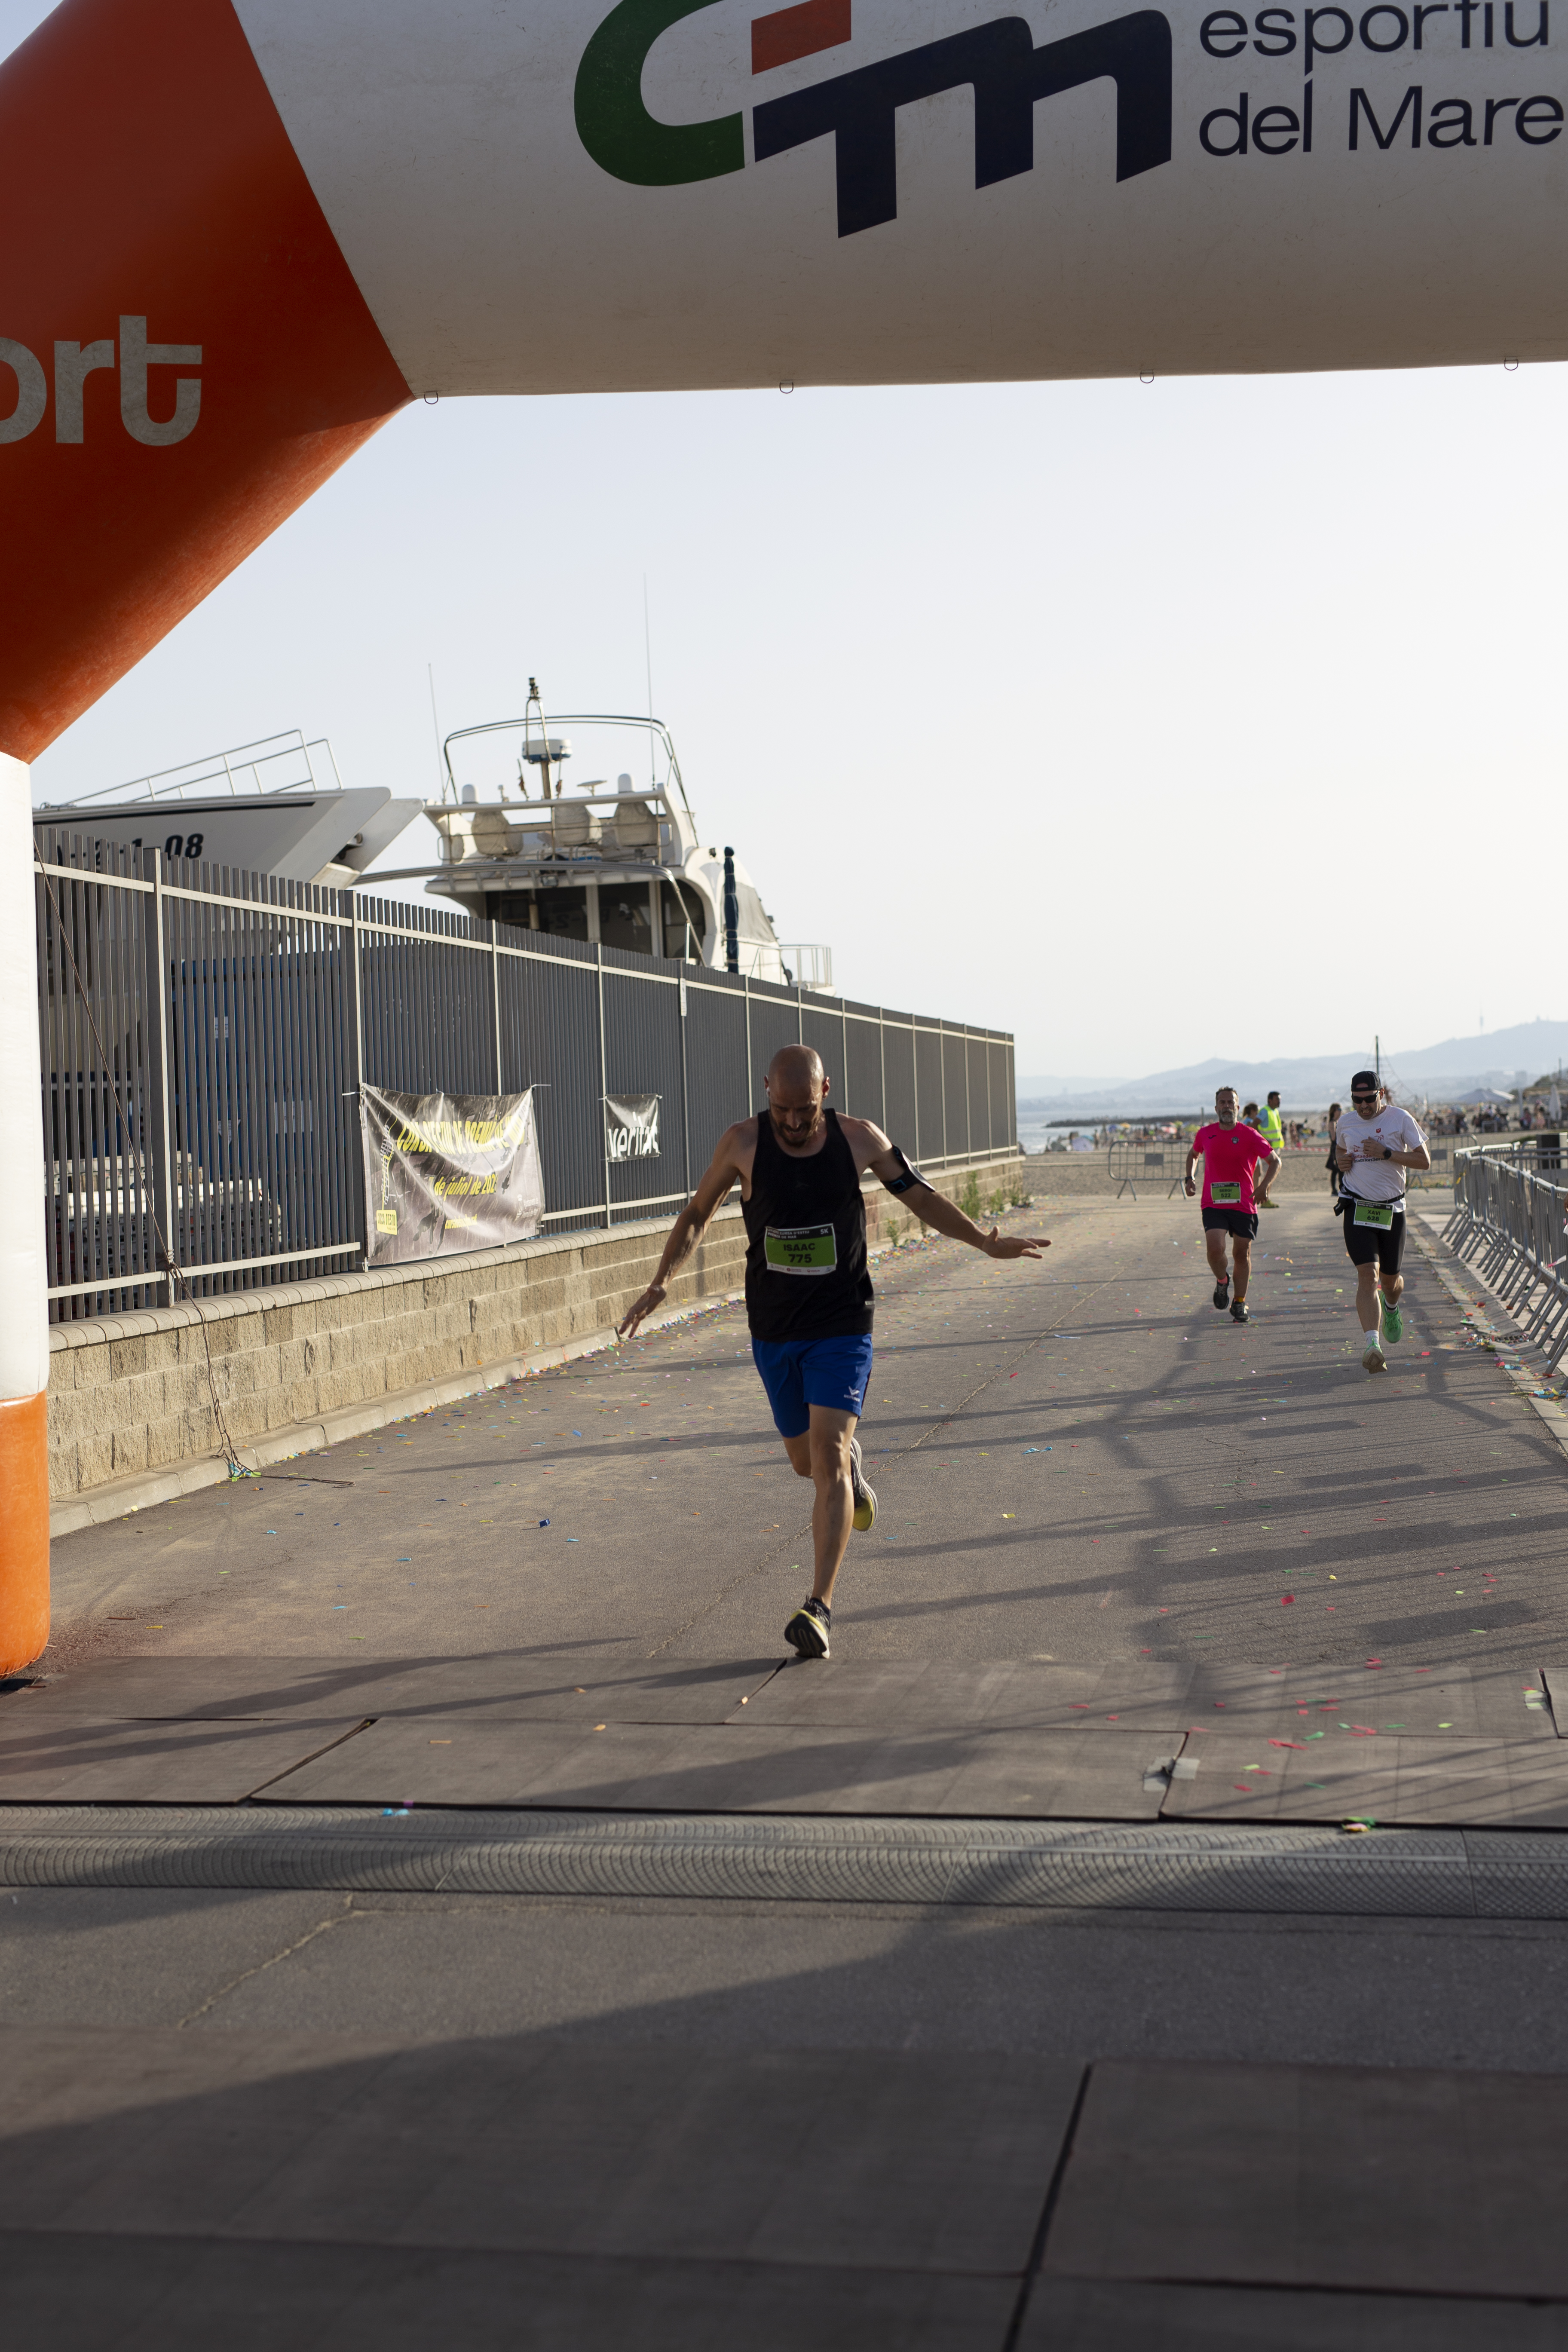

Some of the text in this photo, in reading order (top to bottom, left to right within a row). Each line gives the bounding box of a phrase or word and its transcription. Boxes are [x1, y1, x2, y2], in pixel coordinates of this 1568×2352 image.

[1199, 78, 1313, 156] del
[434, 1176, 446, 1196] de
[443, 1176, 473, 1202] juliol
[470, 1175, 482, 1195] de
[783, 1243, 816, 1251] ISAAC
[788, 1253, 812, 1263] 775
